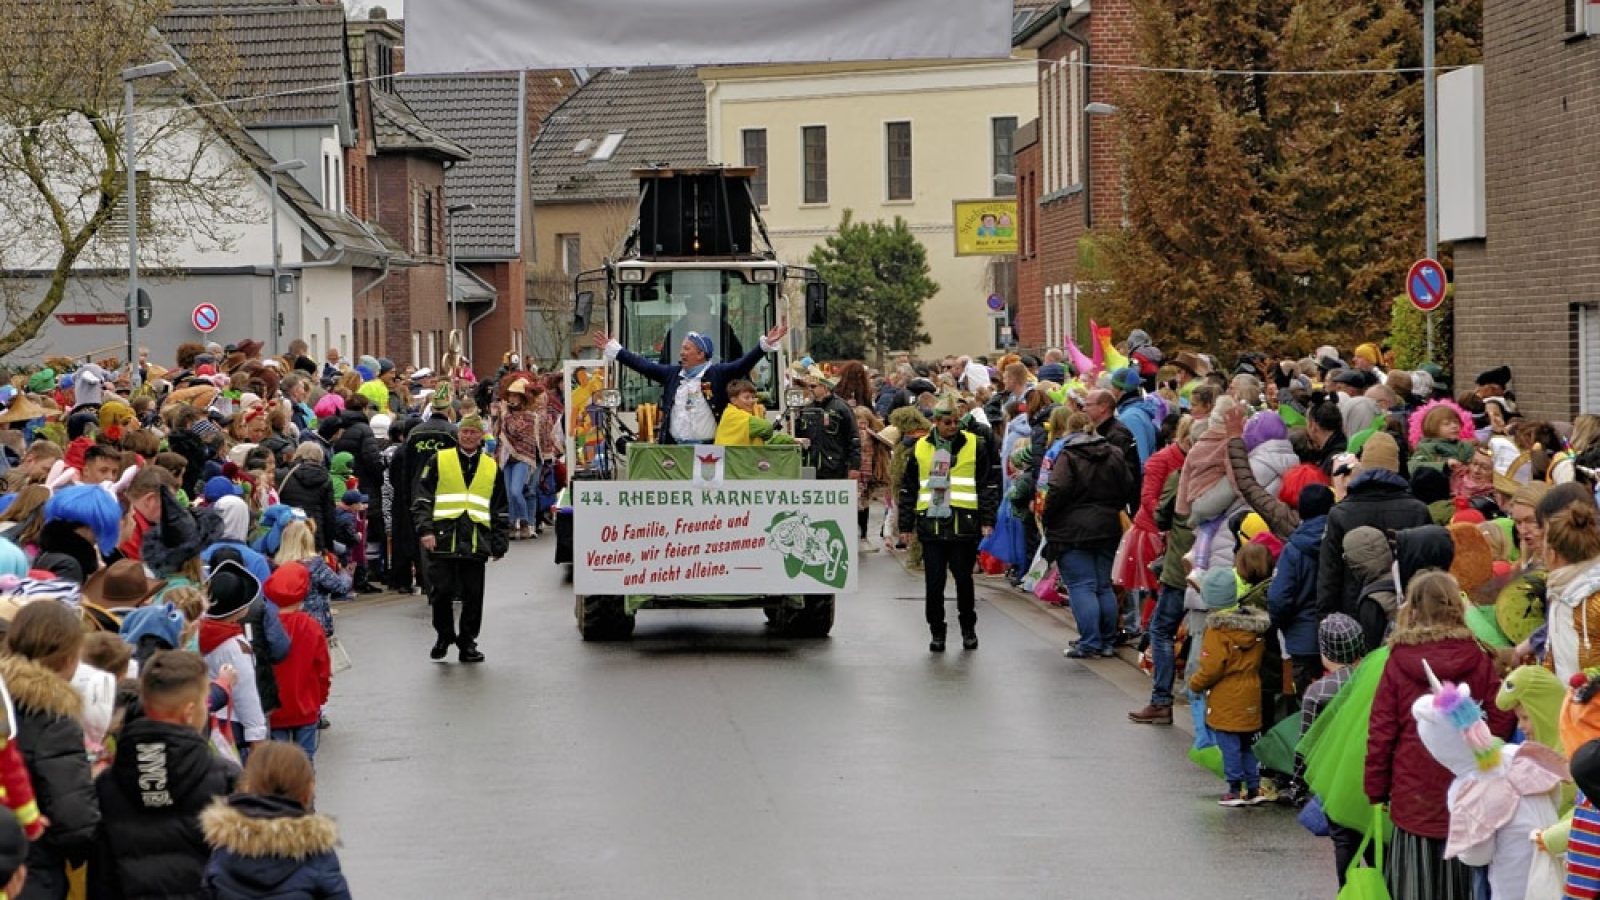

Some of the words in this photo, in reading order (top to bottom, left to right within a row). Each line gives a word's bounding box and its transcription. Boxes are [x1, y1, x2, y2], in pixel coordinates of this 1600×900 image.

[580, 491, 610, 506] 44.
[618, 490, 693, 507] RHEDER
[702, 490, 849, 506] KARNEVALSZUG
[601, 525, 619, 543] Ob
[623, 521, 669, 540] Familie,
[674, 515, 722, 535] Freunde
[727, 511, 750, 528] und
[586, 550, 635, 567] Vereine,
[641, 545, 661, 561] wir
[665, 542, 700, 559] feiern
[704, 536, 766, 554] zusammen
[623, 569, 647, 586] und
[650, 565, 681, 583] nicht
[685, 561, 729, 579] alleine.
